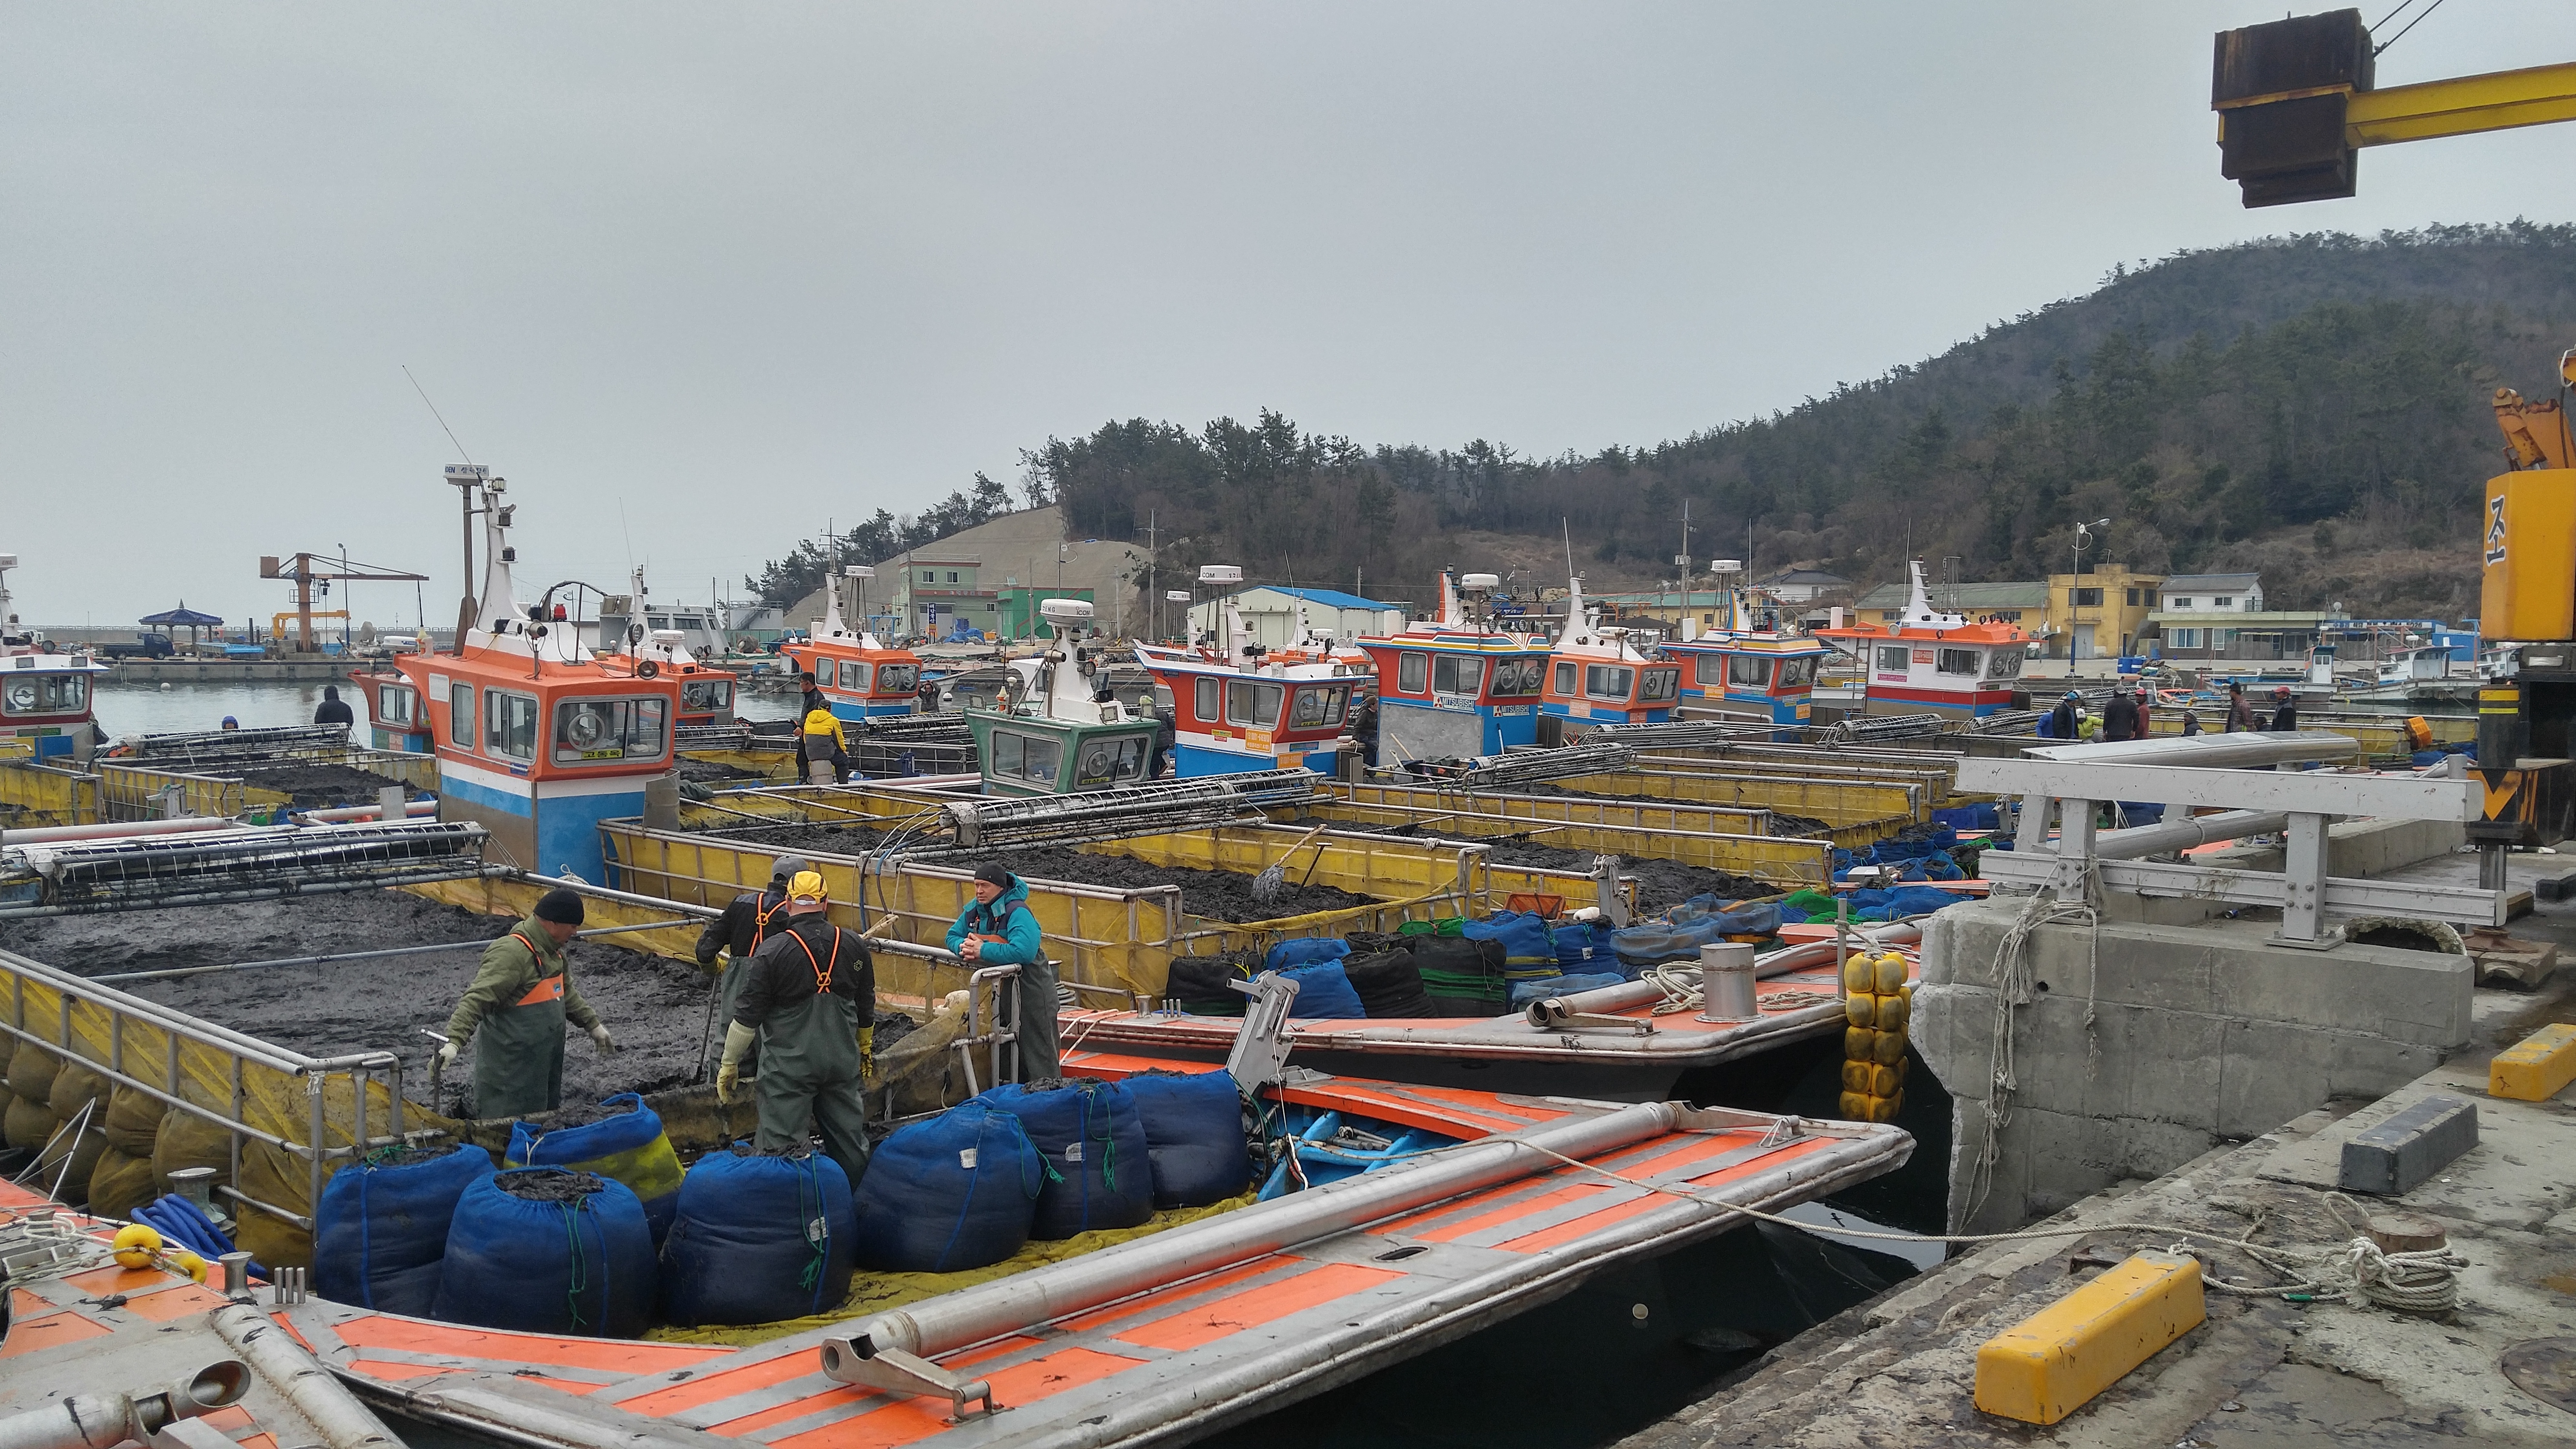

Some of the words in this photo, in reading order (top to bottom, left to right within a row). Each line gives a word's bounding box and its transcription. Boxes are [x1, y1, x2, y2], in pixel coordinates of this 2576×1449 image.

[2486, 496, 2505, 565] 조
[1442, 697, 1474, 708] MITSUBISHI
[1501, 705, 1530, 713] MITSUBISHI
